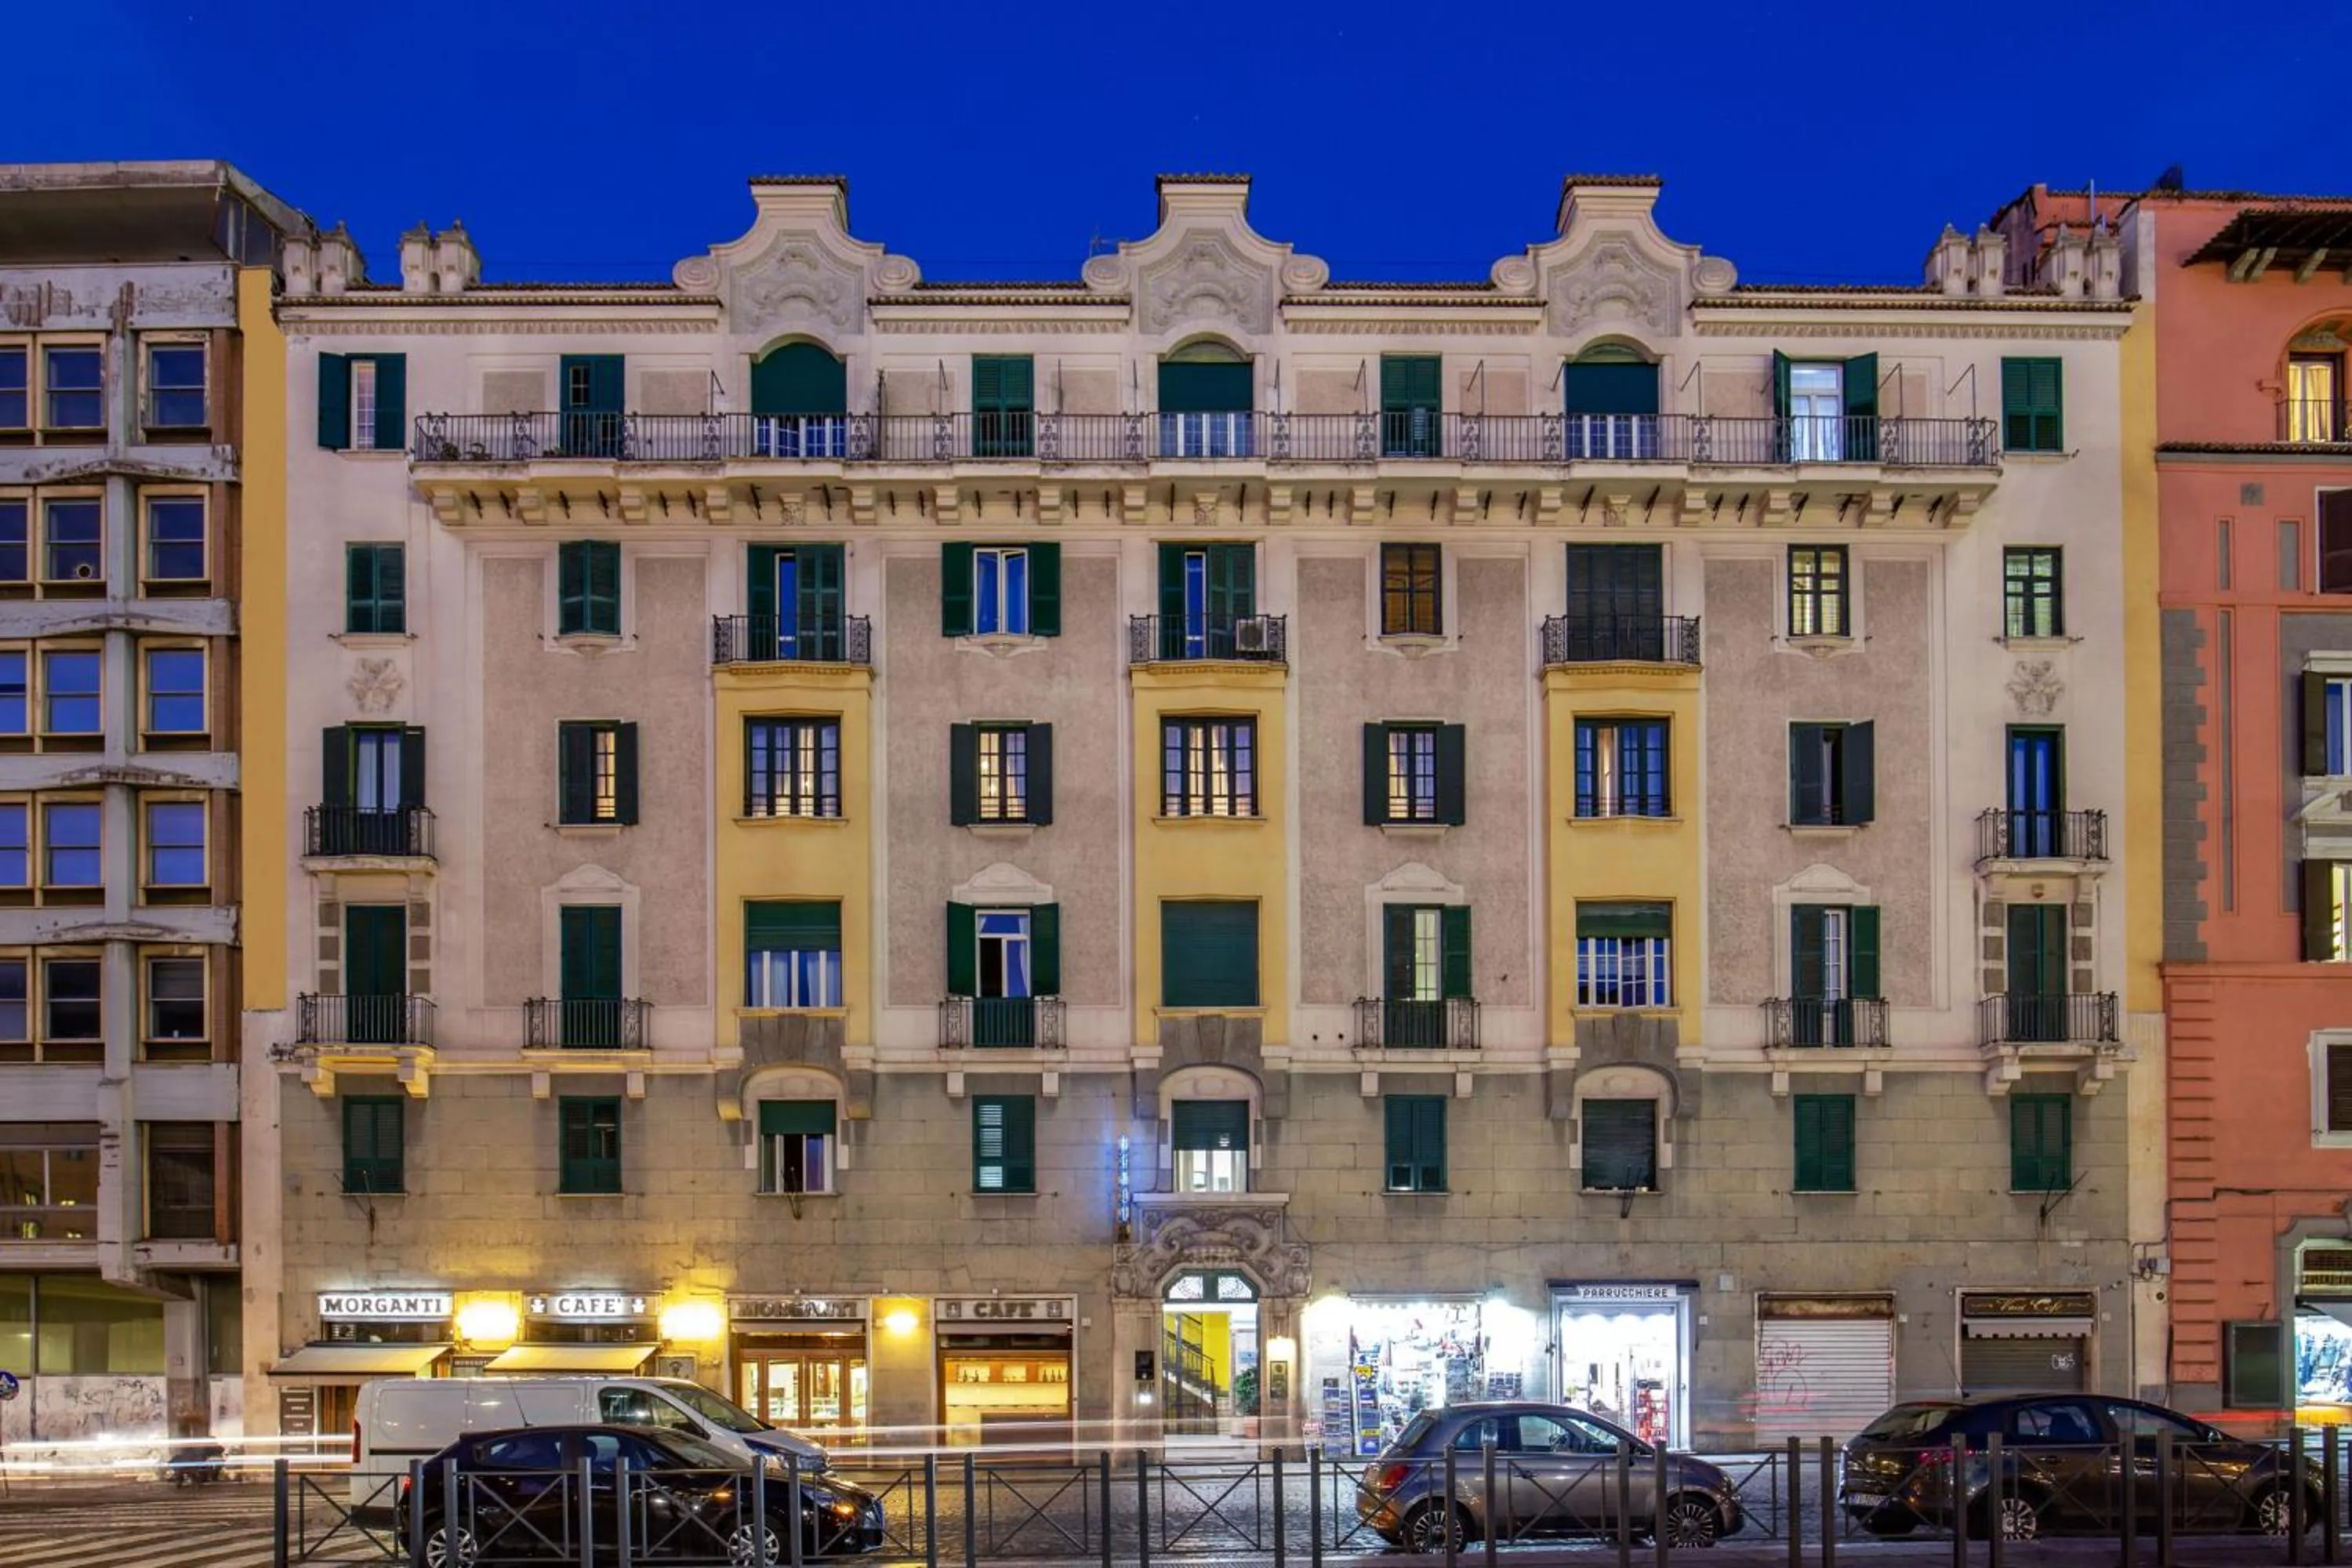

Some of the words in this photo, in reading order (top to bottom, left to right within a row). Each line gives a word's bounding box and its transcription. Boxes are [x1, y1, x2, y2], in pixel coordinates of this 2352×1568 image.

[1583, 1288, 1668, 1298] PARRUCCHIERE
[324, 1298, 442, 1313] MORGANTI
[557, 1298, 622, 1313] CAFE'
[737, 1301, 858, 1318] MORGANTI
